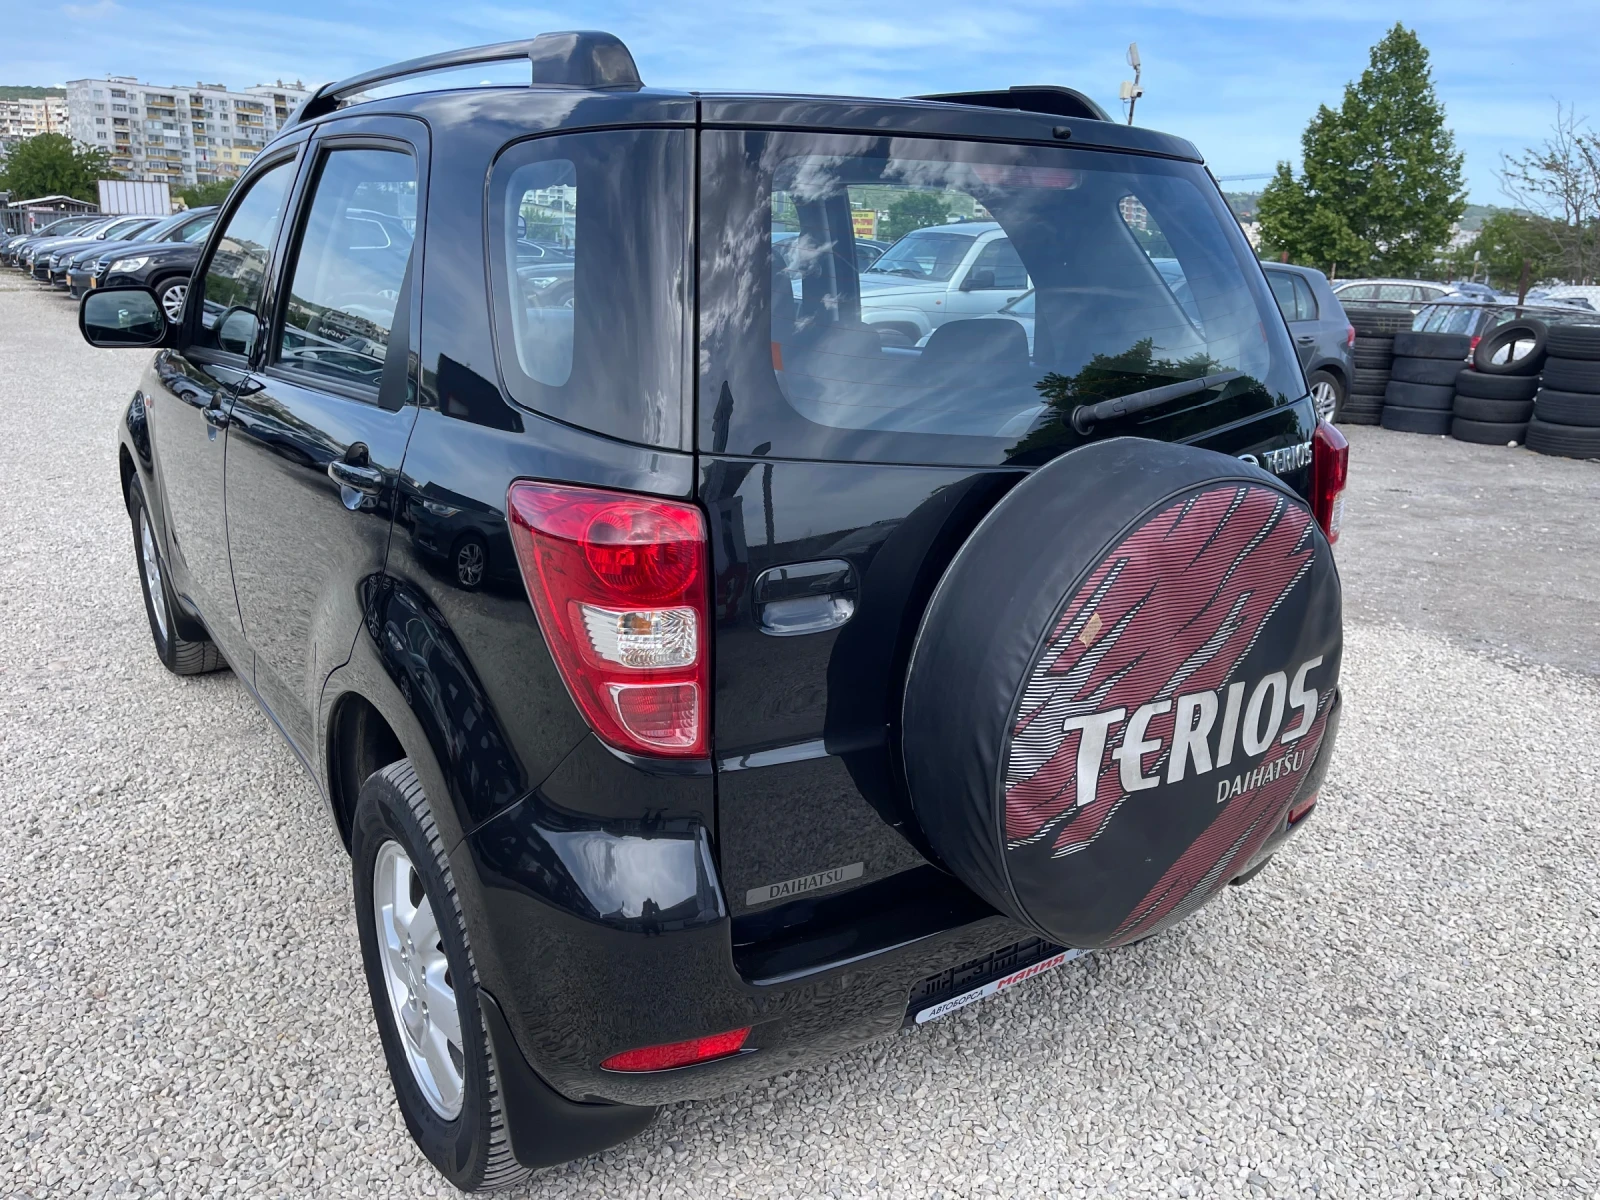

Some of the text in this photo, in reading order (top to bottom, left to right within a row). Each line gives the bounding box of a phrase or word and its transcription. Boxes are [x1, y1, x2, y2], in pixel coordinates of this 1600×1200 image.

[1262, 441, 1312, 474] TERIOS
[1063, 655, 1324, 807] TERIOS
[1215, 750, 1306, 804] DAIHATSU
[769, 868, 844, 899] DAIHATSU
[928, 954, 1065, 1017] АВТОБОРСА МАНИЯ
